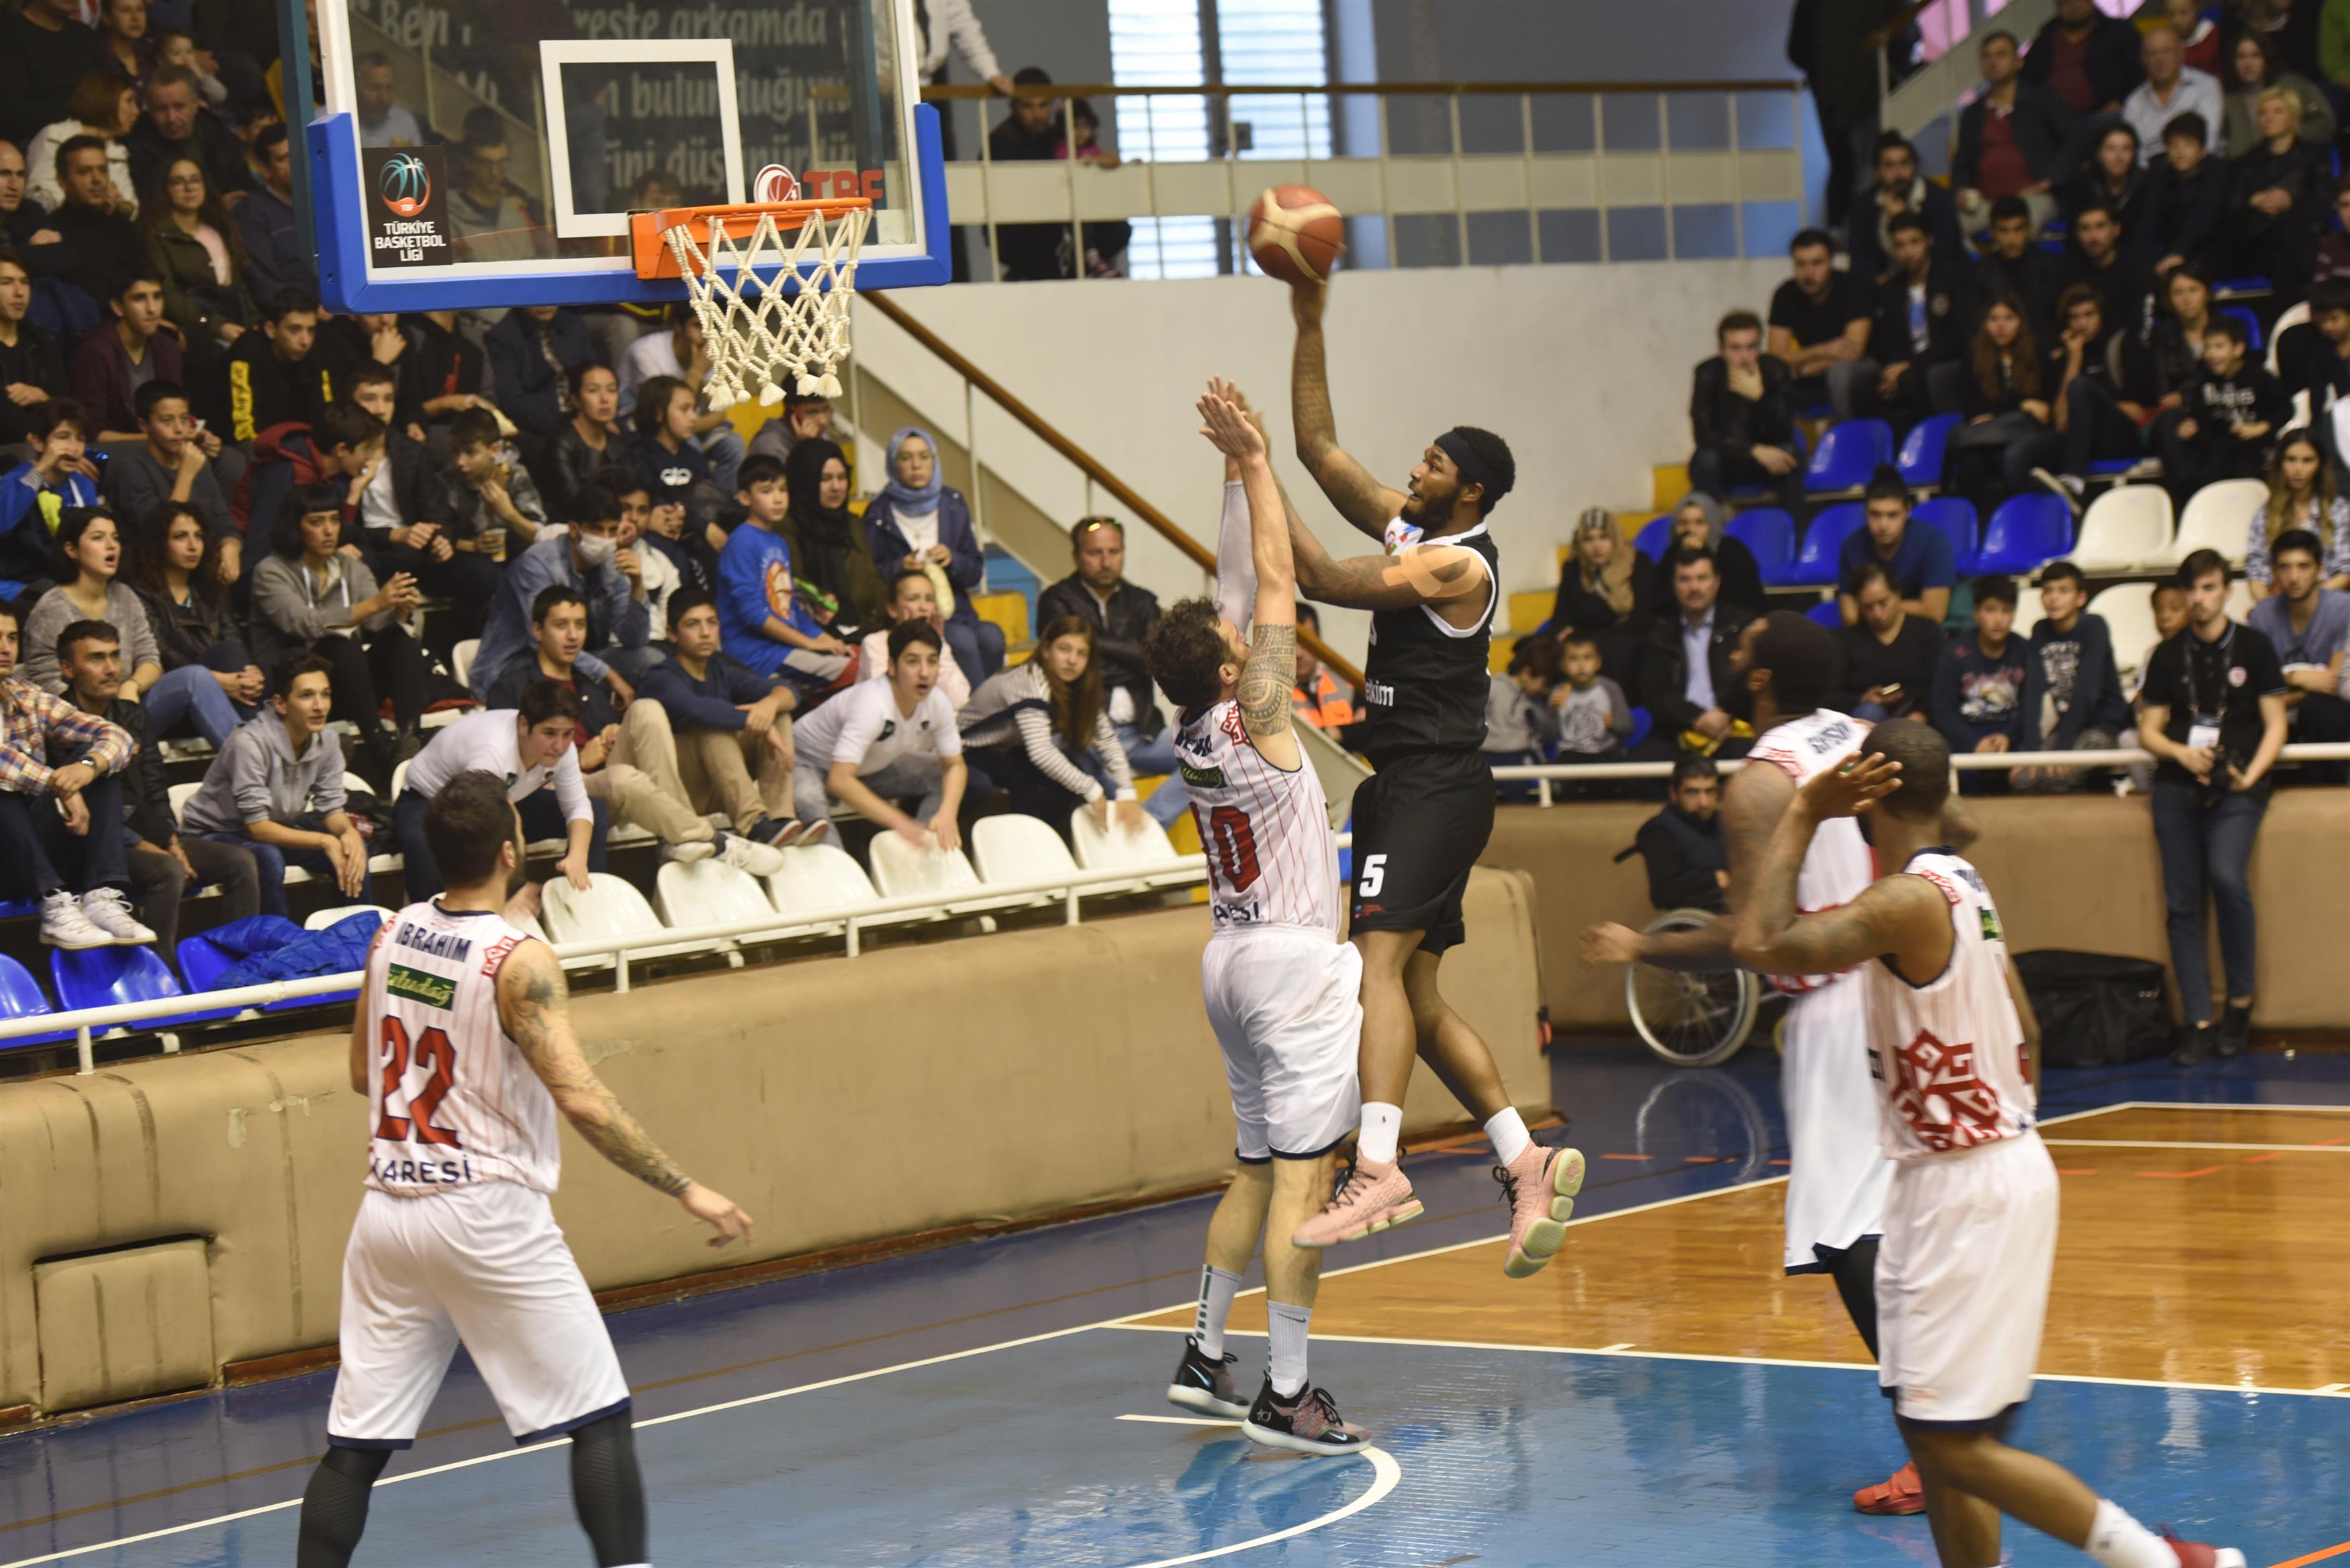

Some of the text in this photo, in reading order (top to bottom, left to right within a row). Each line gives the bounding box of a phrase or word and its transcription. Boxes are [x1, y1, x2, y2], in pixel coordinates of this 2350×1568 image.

[383, 221, 435, 234] TÜRKİYE
[374, 235, 446, 249] BASKETBOL
[399, 247, 424, 261] LİGİ
[1359, 854, 1388, 897] 5
[376, 1014, 461, 1149] 22
